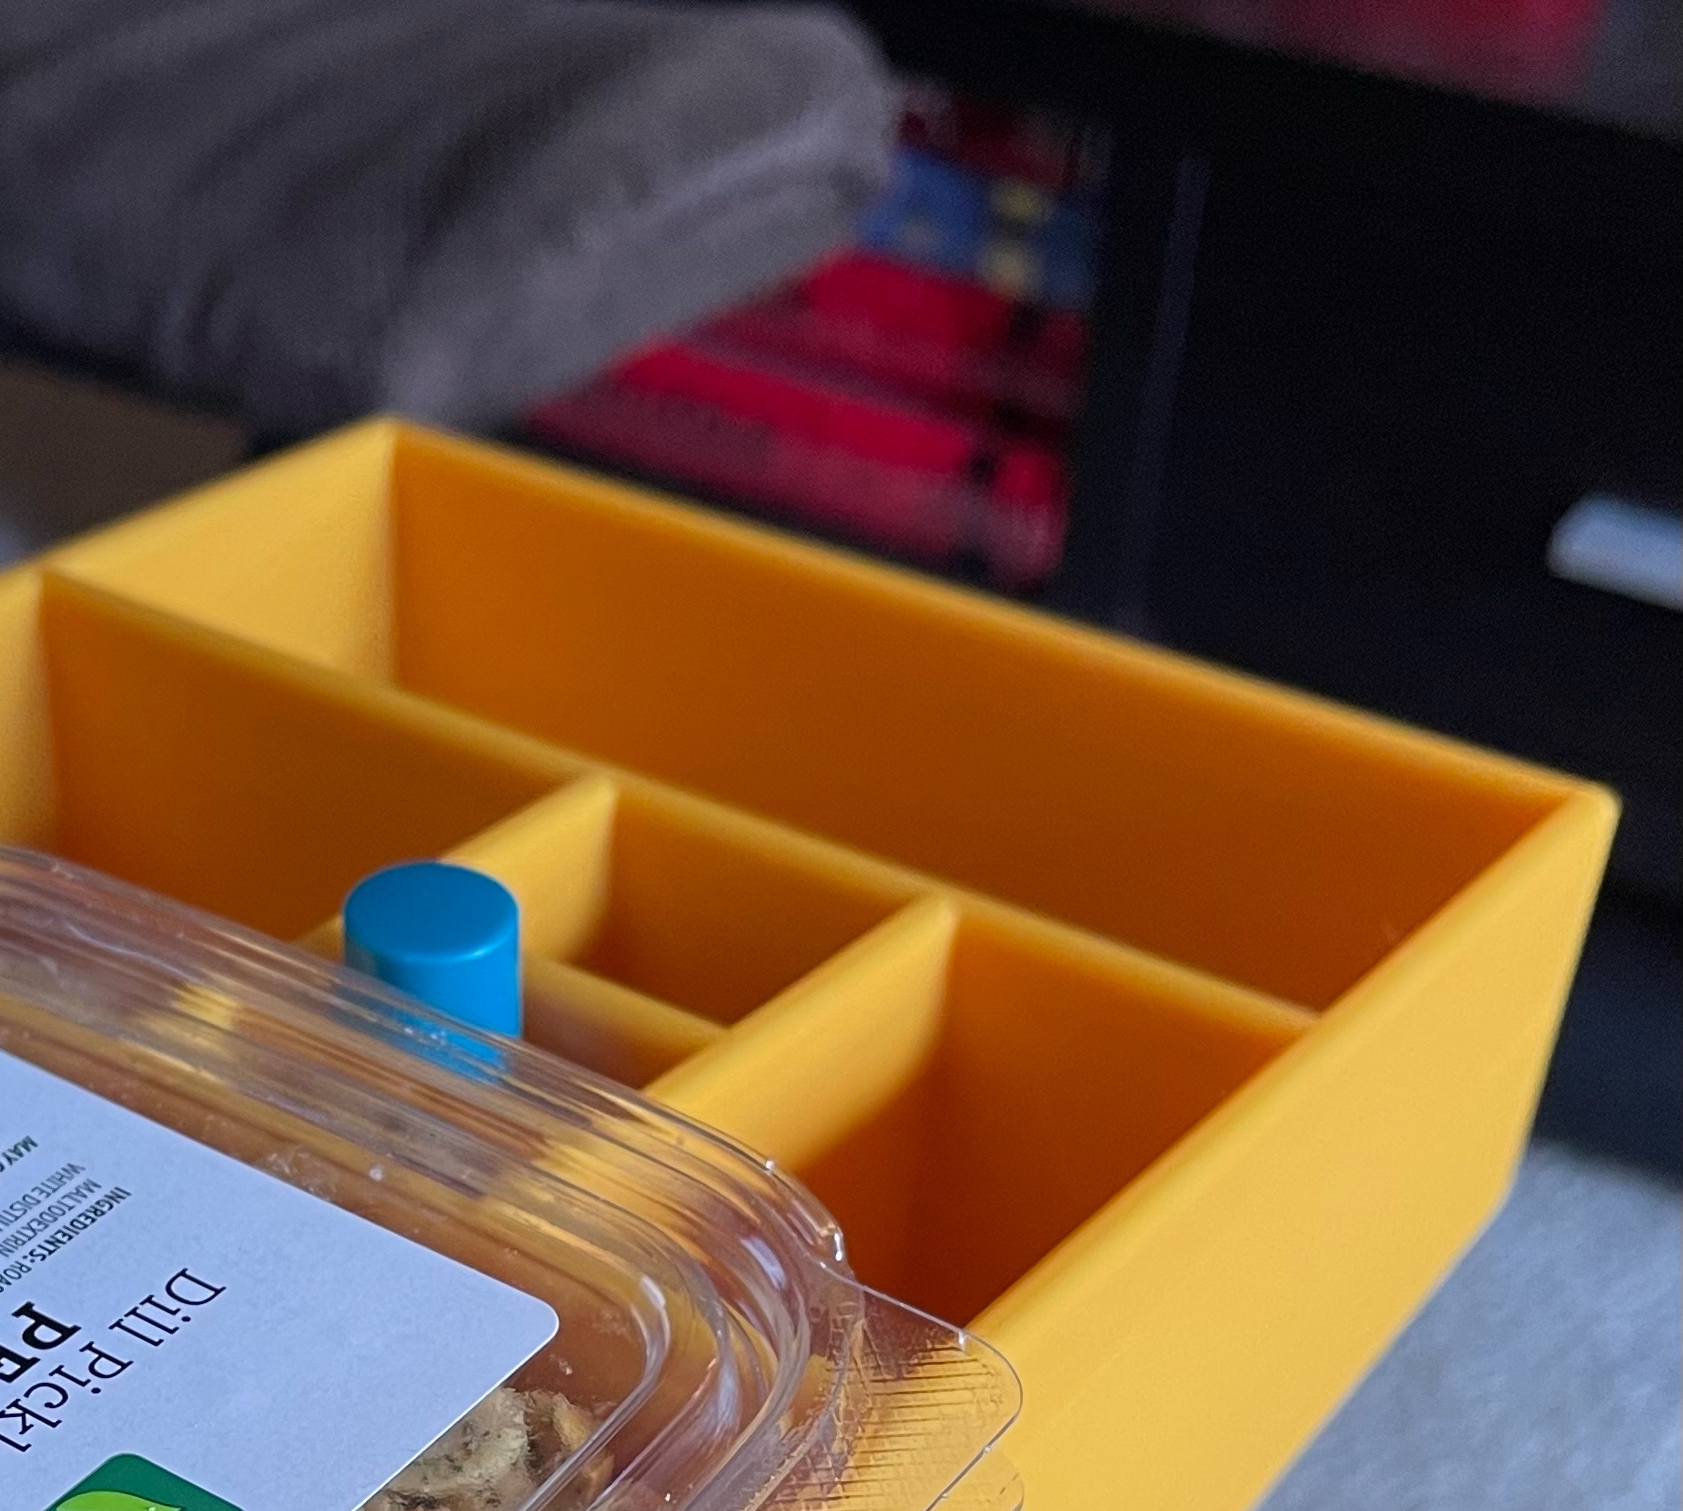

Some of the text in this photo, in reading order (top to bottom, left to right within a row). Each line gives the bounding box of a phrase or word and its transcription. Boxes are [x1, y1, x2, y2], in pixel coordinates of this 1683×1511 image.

[0, 1134, 39, 1166] MAY
[29, 1161, 86, 1199] WHITE
[20, 1185, 132, 1264] INGREDIENTS:
[107, 1266, 227, 1347] Dill
